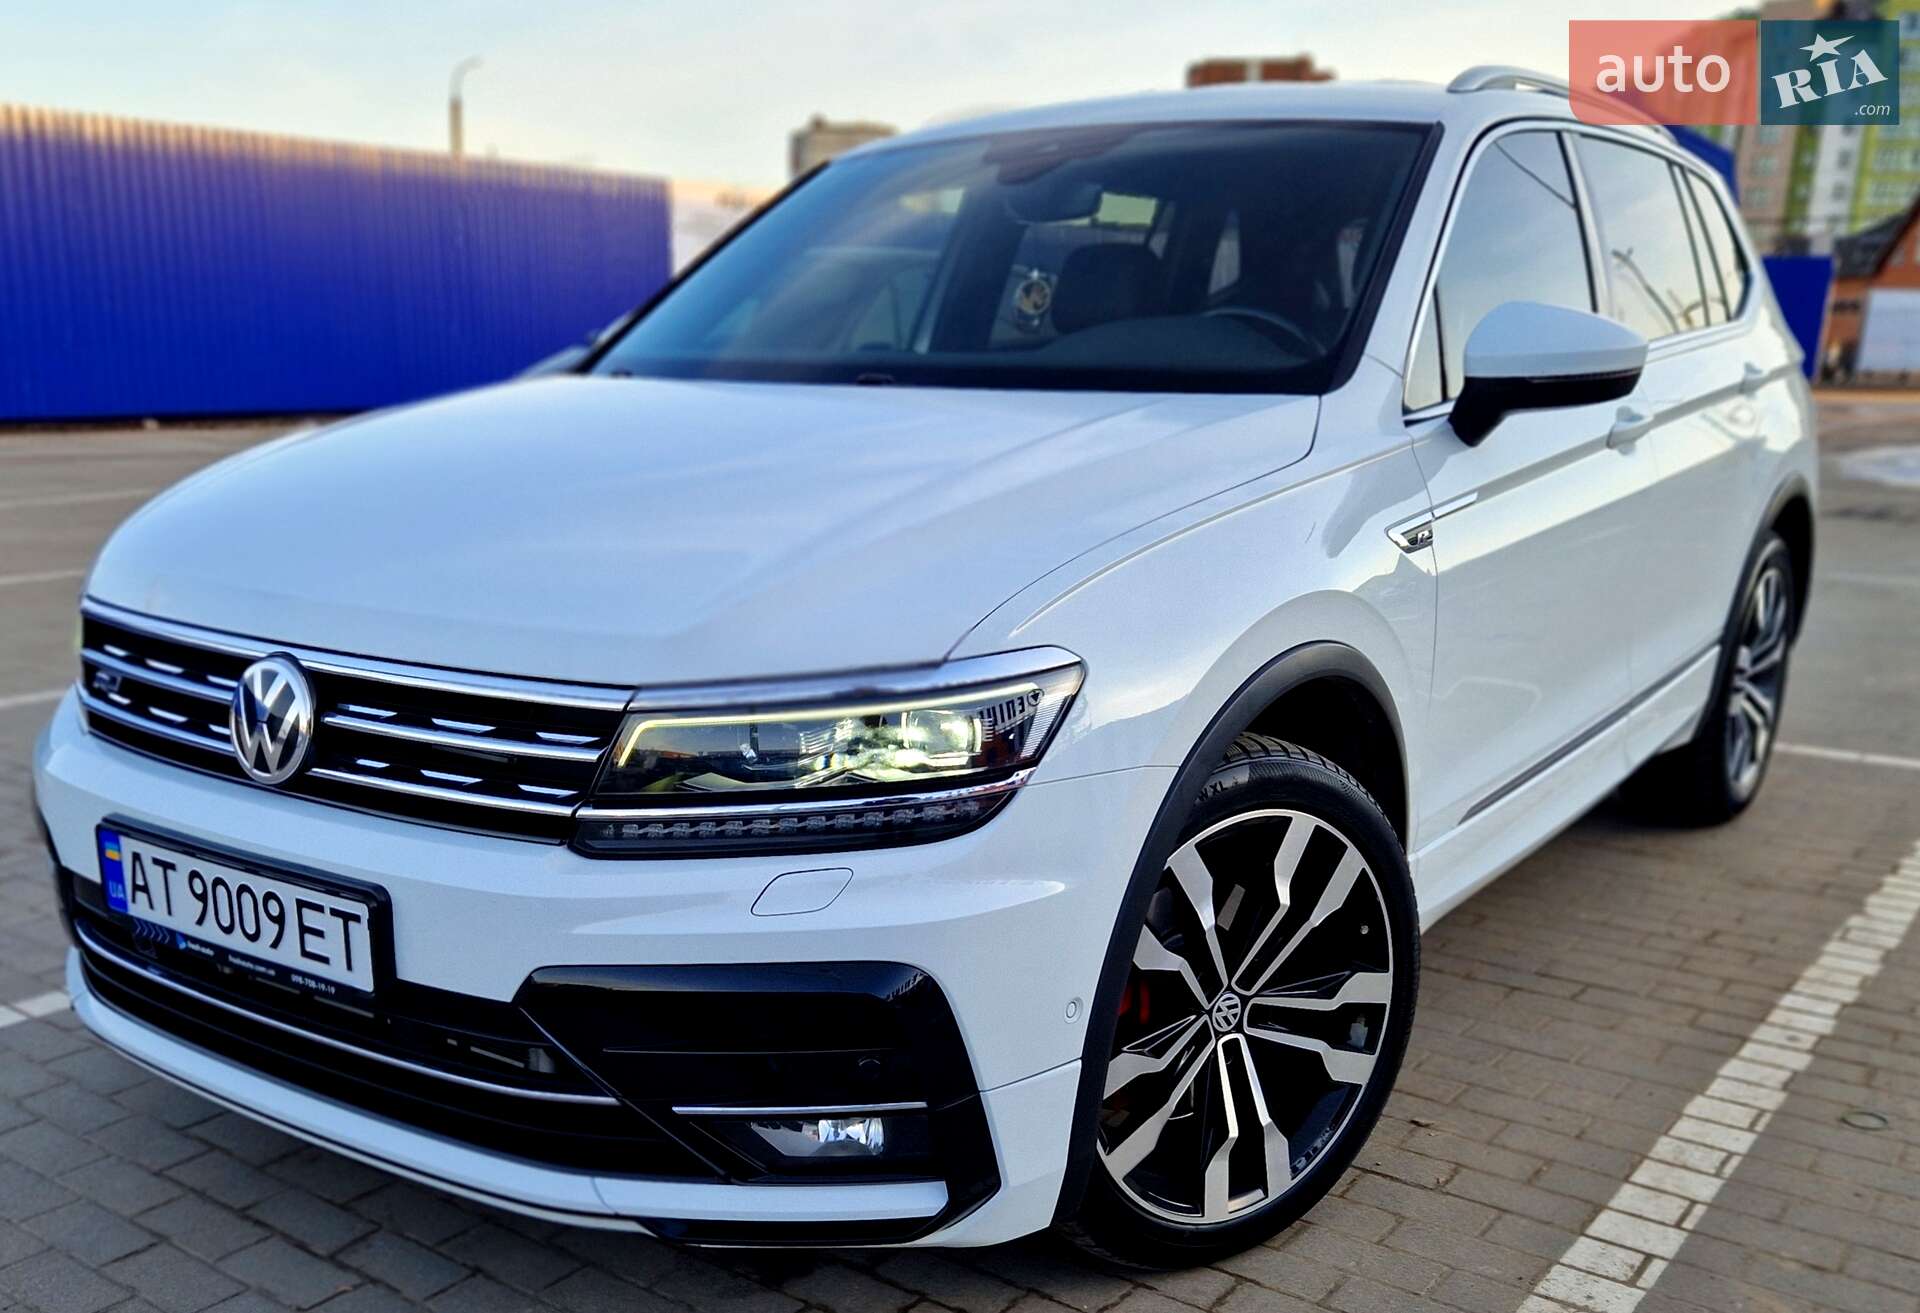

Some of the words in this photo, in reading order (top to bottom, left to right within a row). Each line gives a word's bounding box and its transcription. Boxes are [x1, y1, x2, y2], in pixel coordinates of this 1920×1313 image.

[108, 883, 125, 899] UA
[131, 851, 176, 916] AT
[188, 869, 286, 949] 9009
[295, 896, 362, 972] ET
